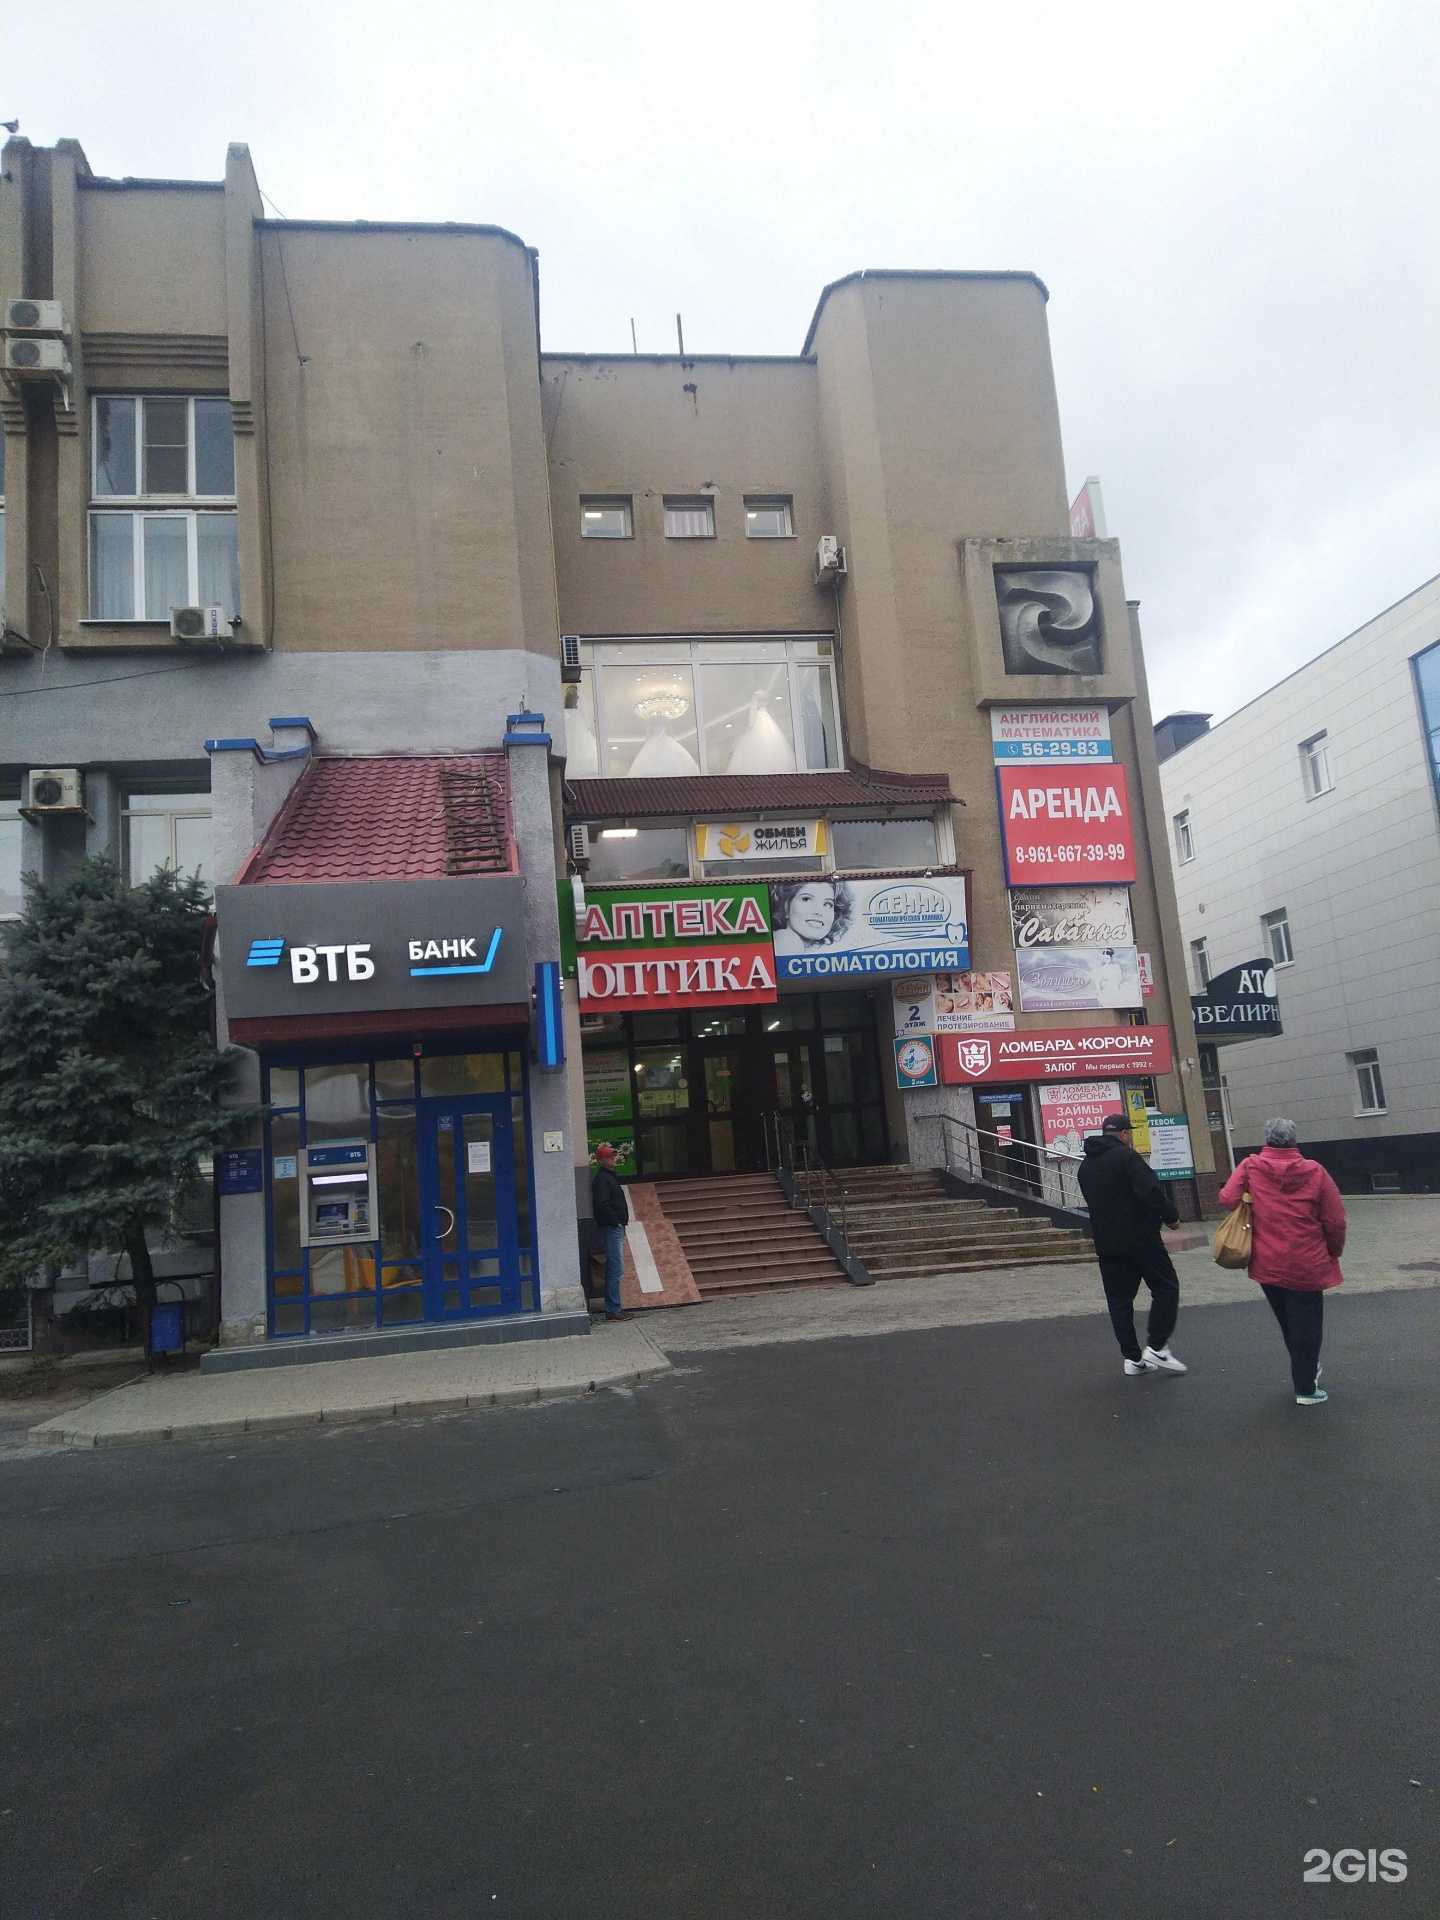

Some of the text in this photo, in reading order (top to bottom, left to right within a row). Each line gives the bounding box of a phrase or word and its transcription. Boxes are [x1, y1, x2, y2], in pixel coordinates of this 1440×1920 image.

[1000, 710, 1100, 724] АНГЛИЙСКИЙ
[1001, 726, 1102, 738] МАТЕМАТИКА
[1021, 741, 1099, 756] 56-29-83
[1009, 786, 1122, 823] АРЕНДА
[754, 826, 806, 839] ОБМЕН
[754, 838, 808, 851] ЖИЛЬЯ
[1015, 843, 1125, 863] 8-961-667-39-99
[583, 897, 769, 942] АПТЕКА
[408, 937, 477, 961] БАНК
[289, 943, 375, 984] ВТБ
[787, 950, 959, 976] СТОМАТОЛОГИЯ
[908, 1005, 921, 1021] 2
[937, 1014, 973, 1022] ЛЕЧЕНИЕ
[1192, 1003, 1281, 1024] ВЕЛИРН
[937, 1021, 1011, 1031] ПРОТЕЗИРОВАНИЕ
[999, 1039, 1075, 1054] ЛОМБАРД
[1044, 1062, 1077, 1073] ЗАЛОГ
[1085, 1063, 1098, 1071] Мы
[1099, 1063, 1125, 1071] первые
[1062, 1085, 1112, 1093] ЛОМБАРД
[1056, 1104, 1104, 1117] ЗАЙМЫ
[1047, 1118, 1075, 1129] ПОД
